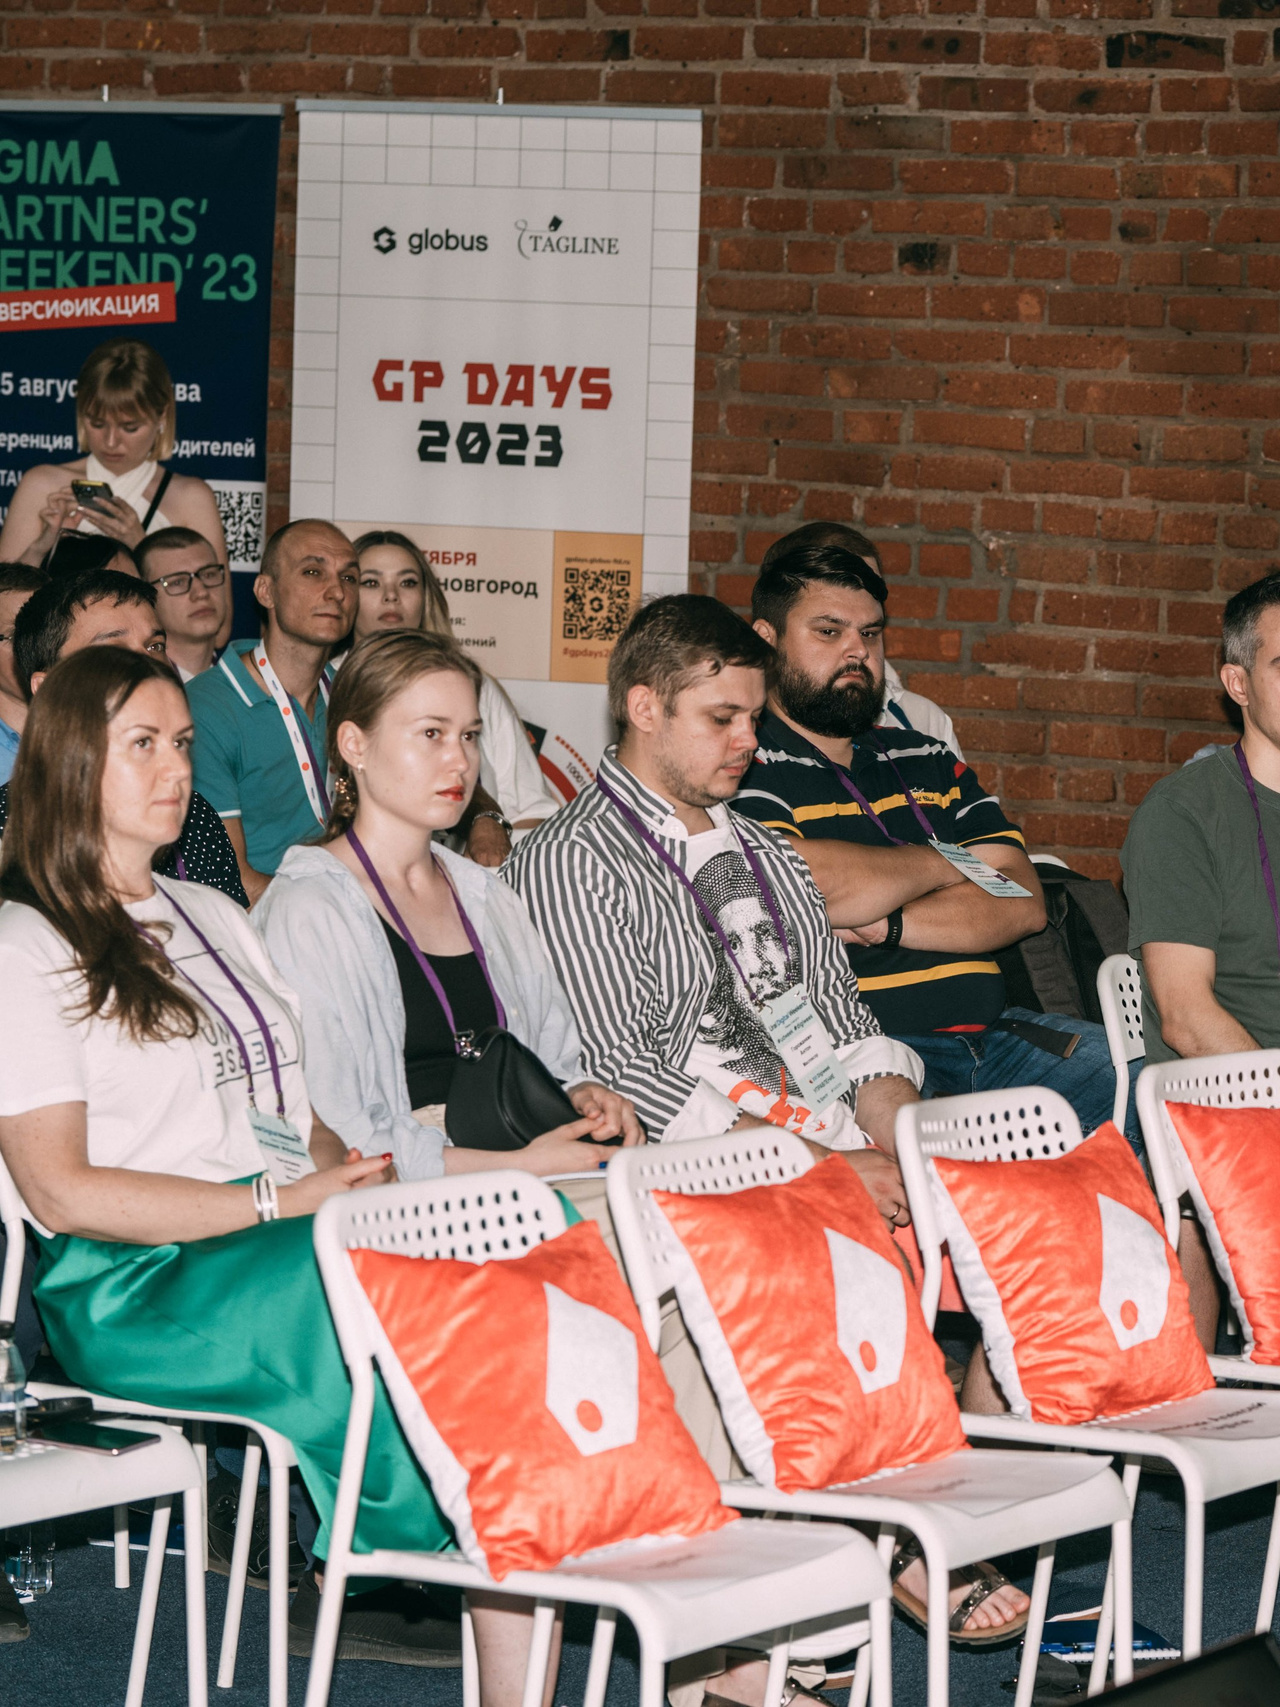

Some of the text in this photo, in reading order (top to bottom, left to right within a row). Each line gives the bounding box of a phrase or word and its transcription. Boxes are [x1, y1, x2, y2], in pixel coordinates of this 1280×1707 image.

[408, 228, 489, 256] globus
[528, 234, 620, 256] TAGLINE
[19, 377, 78, 403] авгус
[372, 359, 613, 410] GP DAYS
[416, 420, 564, 468] 2023
